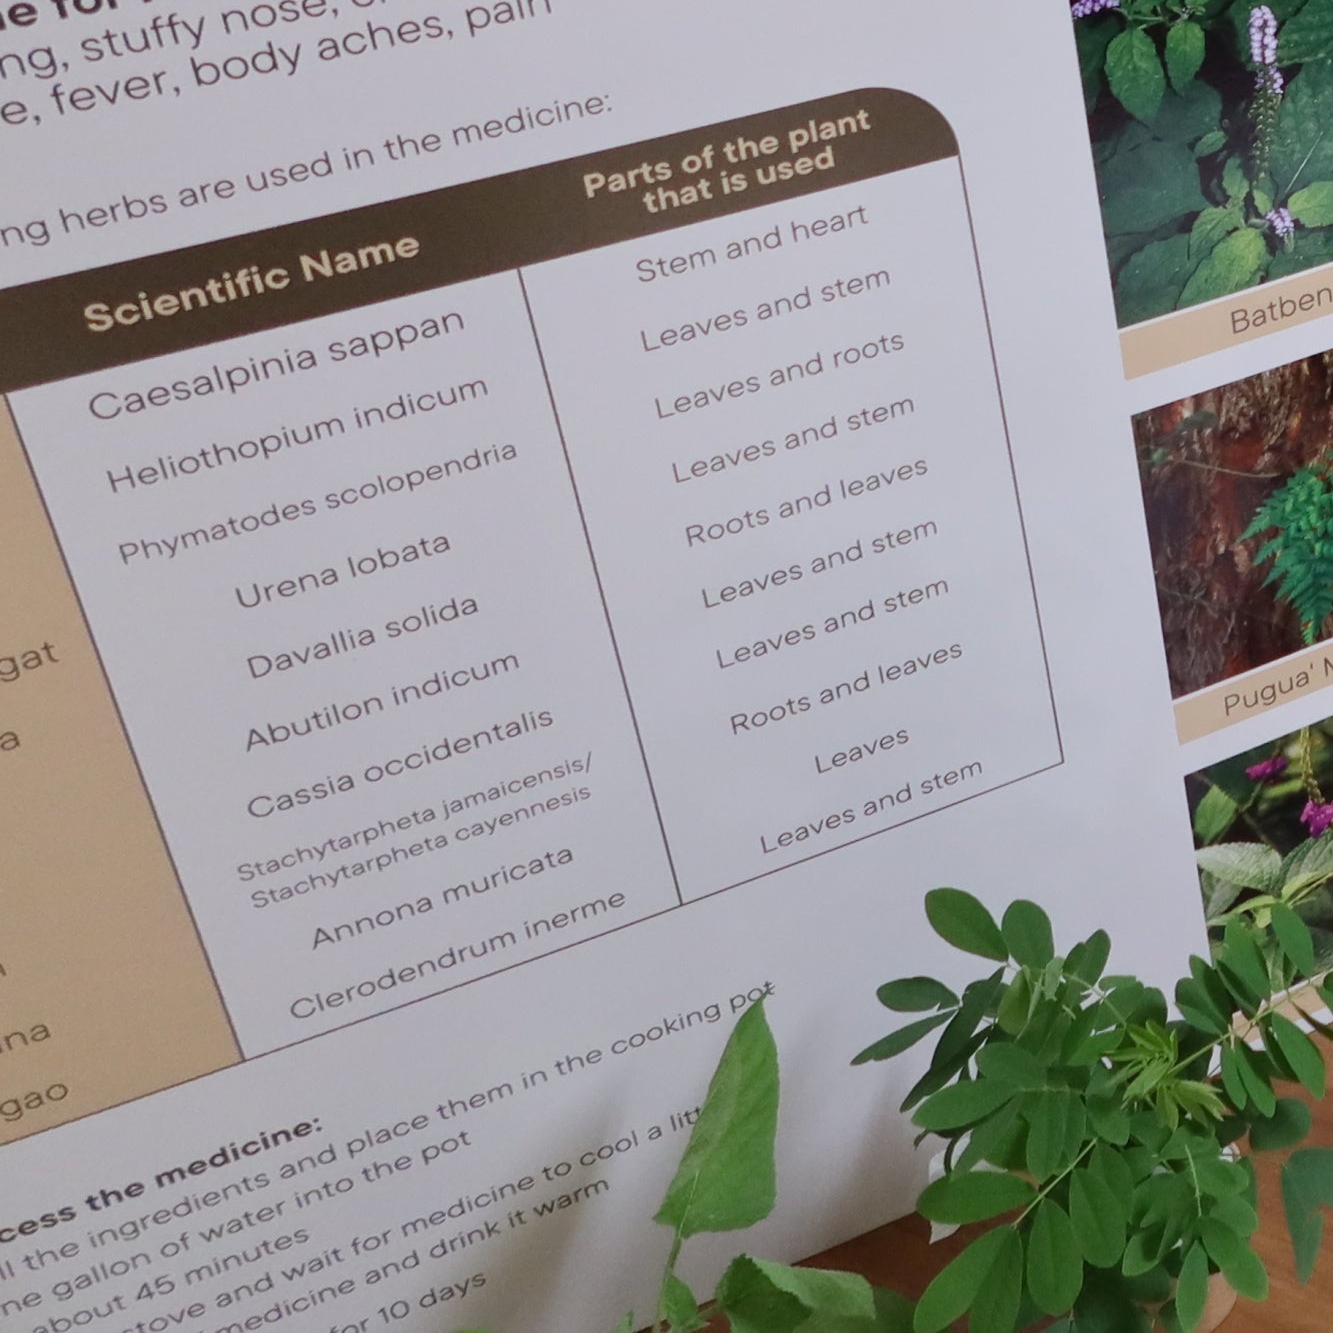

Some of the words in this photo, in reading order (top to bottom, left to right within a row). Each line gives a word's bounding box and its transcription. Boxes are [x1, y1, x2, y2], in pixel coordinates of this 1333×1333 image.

[0, 2, 38, 31] e
[0, 46, 69, 80] ng,
[80, 12, 205, 62] stuffy
[0, 101, 41, 126] e,
[49, 71, 180, 115] fever,
[190, 41, 301, 87] body
[317, 16, 453, 61] aches,
[0, 220, 50, 247] ng
[59, 195, 168, 233] herbs
[179, 180, 235, 207] are
[246, 151, 333, 192] used
[342, 147, 374, 170] in
[383, 134, 442, 160] the
[452, 95, 612, 146] medicine:
[583, 162, 672, 198] Parts
[681, 145, 714, 173] of
[723, 136, 779, 163] the
[789, 109, 871, 154] plant
[643, 179, 713, 213] that
[720, 171, 748, 194] is
[756, 145, 835, 184] used
[84, 266, 290, 332] Scientific
[299, 237, 419, 281] Name
[636, 249, 716, 282] Stem
[727, 225, 782, 259] and
[790, 205, 868, 242] heart
[640, 310, 748, 352] Leaves
[757, 286, 812, 320] and
[821, 270, 890, 302] stem
[89, 349, 317, 420] Caesalpinia
[328, 313, 464, 362] sappan
[655, 376, 760, 419] Leaves
[770, 352, 824, 386] and
[833, 335, 904, 368] roots
[106, 418, 345, 493] Heliothopium
[353, 380, 488, 429] indicum
[672, 440, 776, 483] Leaves
[785, 416, 838, 450] and
[847, 399, 914, 431] stem
[119, 500, 316, 565] Phymatodes
[325, 444, 517, 509] scolopendria
[685, 509, 770, 547] Roots
[779, 484, 831, 518] and
[840, 460, 928, 499] leaves
[235, 568, 339, 608] Urena
[347, 536, 451, 578] lobata
[702, 565, 803, 608] Leaves
[811, 539, 863, 574] and
[872, 521, 937, 553] stem
[0, 642, 59, 682] gat
[247, 629, 376, 679] Davallia
[385, 598, 478, 638] solida
[716, 625, 816, 669] Leaves
[824, 599, 875, 633] and
[884, 580, 948, 612] stem
[246, 697, 384, 753] Abutilon
[392, 655, 519, 706] indicum
[730, 697, 811, 735] Roots
[820, 670, 870, 704] and
[878, 644, 962, 684] leaves
[247, 775, 355, 818] Cassia
[364, 711, 553, 782] occidentalis
[815, 730, 909, 774] Leaves
[237, 808, 436, 881] Stachytarpheta
[443, 751, 591, 821] jamaicensis/
[251, 835, 448, 908] Stachytarpheta
[455, 787, 591, 841] cayennesis
[760, 809, 855, 854] Leaves
[864, 782, 912, 816] and
[921, 762, 982, 794] stem
[313, 897, 433, 950] Annona
[443, 849, 573, 904] muricata
[290, 932, 516, 1018] Clerodendrum
[524, 893, 625, 939] inerme
[0, 1024, 51, 1054] na
[0, 1083, 69, 1122] gao
[22, 1242, 80, 1270] the
[87, 1173, 270, 1248] ingredients
[280, 1143, 337, 1179] and
[346, 1115, 429, 1159] place
[436, 1083, 513, 1119] them
[521, 1070, 548, 1089] in
[554, 1050, 602, 1075] the
[611, 1003, 721, 1054] cooking
[729, 980, 776, 1014] pot
[0, 1206, 77, 1243] cess
[84, 1182, 145, 1211] the
[154, 1118, 322, 1189] medicine:
[0, 1292, 42, 1316] ne
[51, 1253, 152, 1301] gallon
[160, 1232, 189, 1258] of
[198, 1201, 285, 1242] water
[294, 1178, 354, 1208] into
[361, 1156, 412, 1182] the
[421, 1131, 471, 1165] pot
[215, 1272, 274, 1308] and
[281, 1248, 344, 1281] wait
[351, 1230, 391, 1255] for
[401, 1176, 534, 1237] medicine
[542, 1162, 572, 1181] to
[580, 1130, 638, 1166] cool
[648, 1126, 662, 1140] a
[136, 1274, 175, 1301] 45
[185, 1229, 310, 1285] minutes
[365, 1250, 420, 1284] and
[430, 1221, 501, 1258] drink
[508, 1210, 527, 1228] it
[533, 1180, 609, 1217] warm
[378, 1300, 410, 1323] 10
[419, 1274, 486, 1308] days
